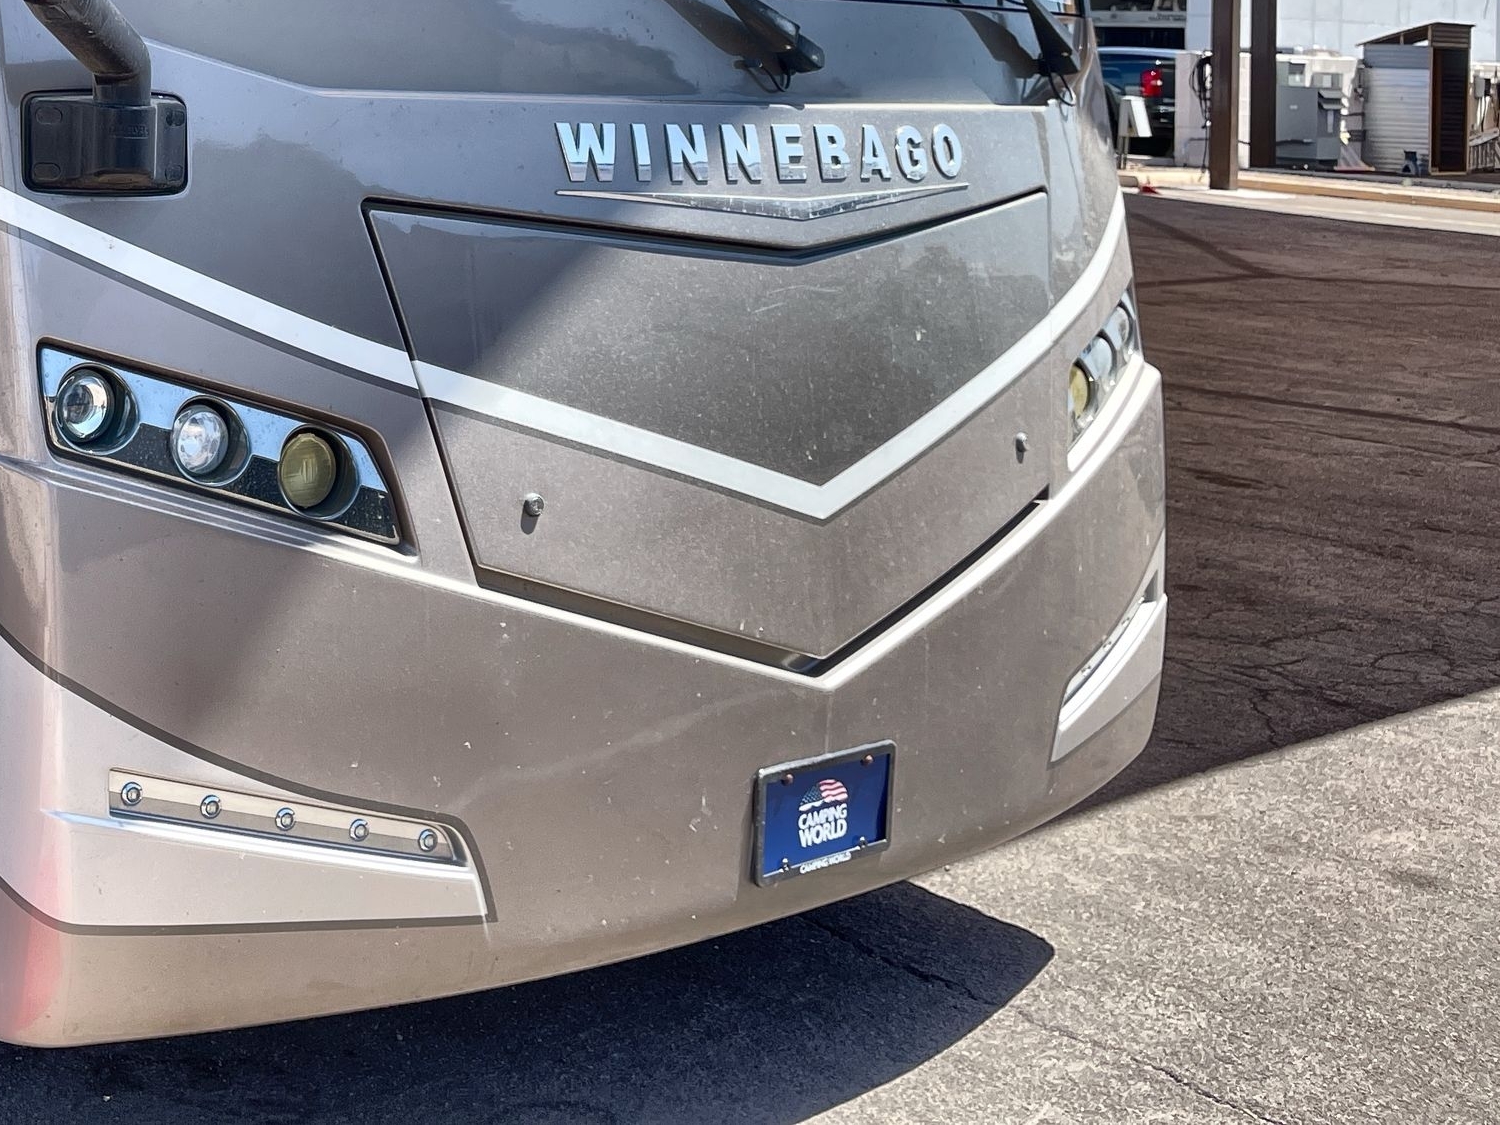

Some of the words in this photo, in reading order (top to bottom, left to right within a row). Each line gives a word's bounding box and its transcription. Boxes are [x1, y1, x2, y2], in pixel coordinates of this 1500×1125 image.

[553, 121, 964, 183] WINNEBAGO
[798, 803, 848, 829] CAMPING
[798, 819, 848, 848] WORLD
